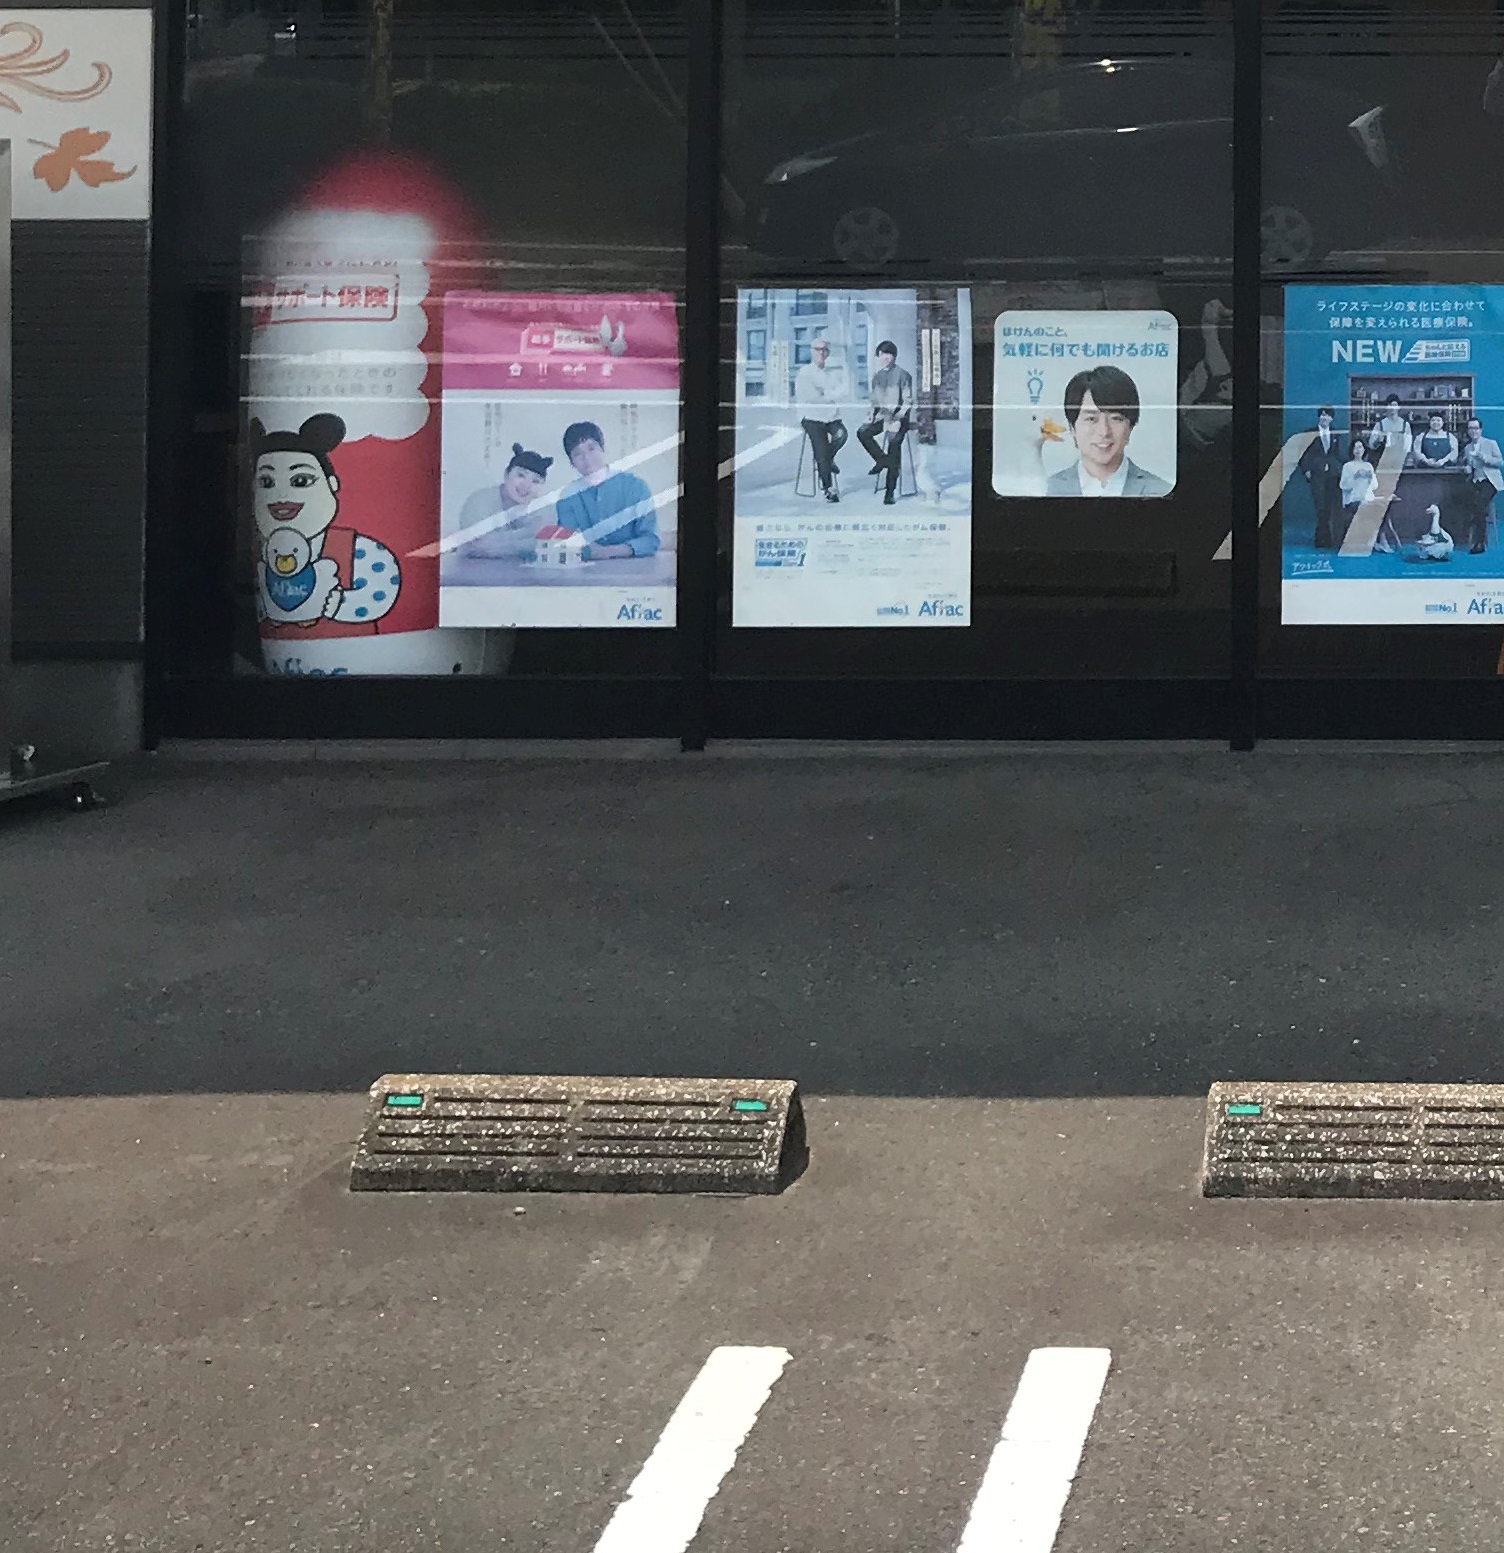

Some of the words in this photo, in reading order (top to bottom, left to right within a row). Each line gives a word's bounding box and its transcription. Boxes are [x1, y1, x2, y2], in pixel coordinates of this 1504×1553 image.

[1315, 299, 1486, 313] ライフステージの変化に合わせて
[1002, 326, 1068, 338] ほけんのこと、
[1002, 342, 1170, 358] 気軽に何でも聞けるお店
[1331, 339, 1403, 364] NEW
